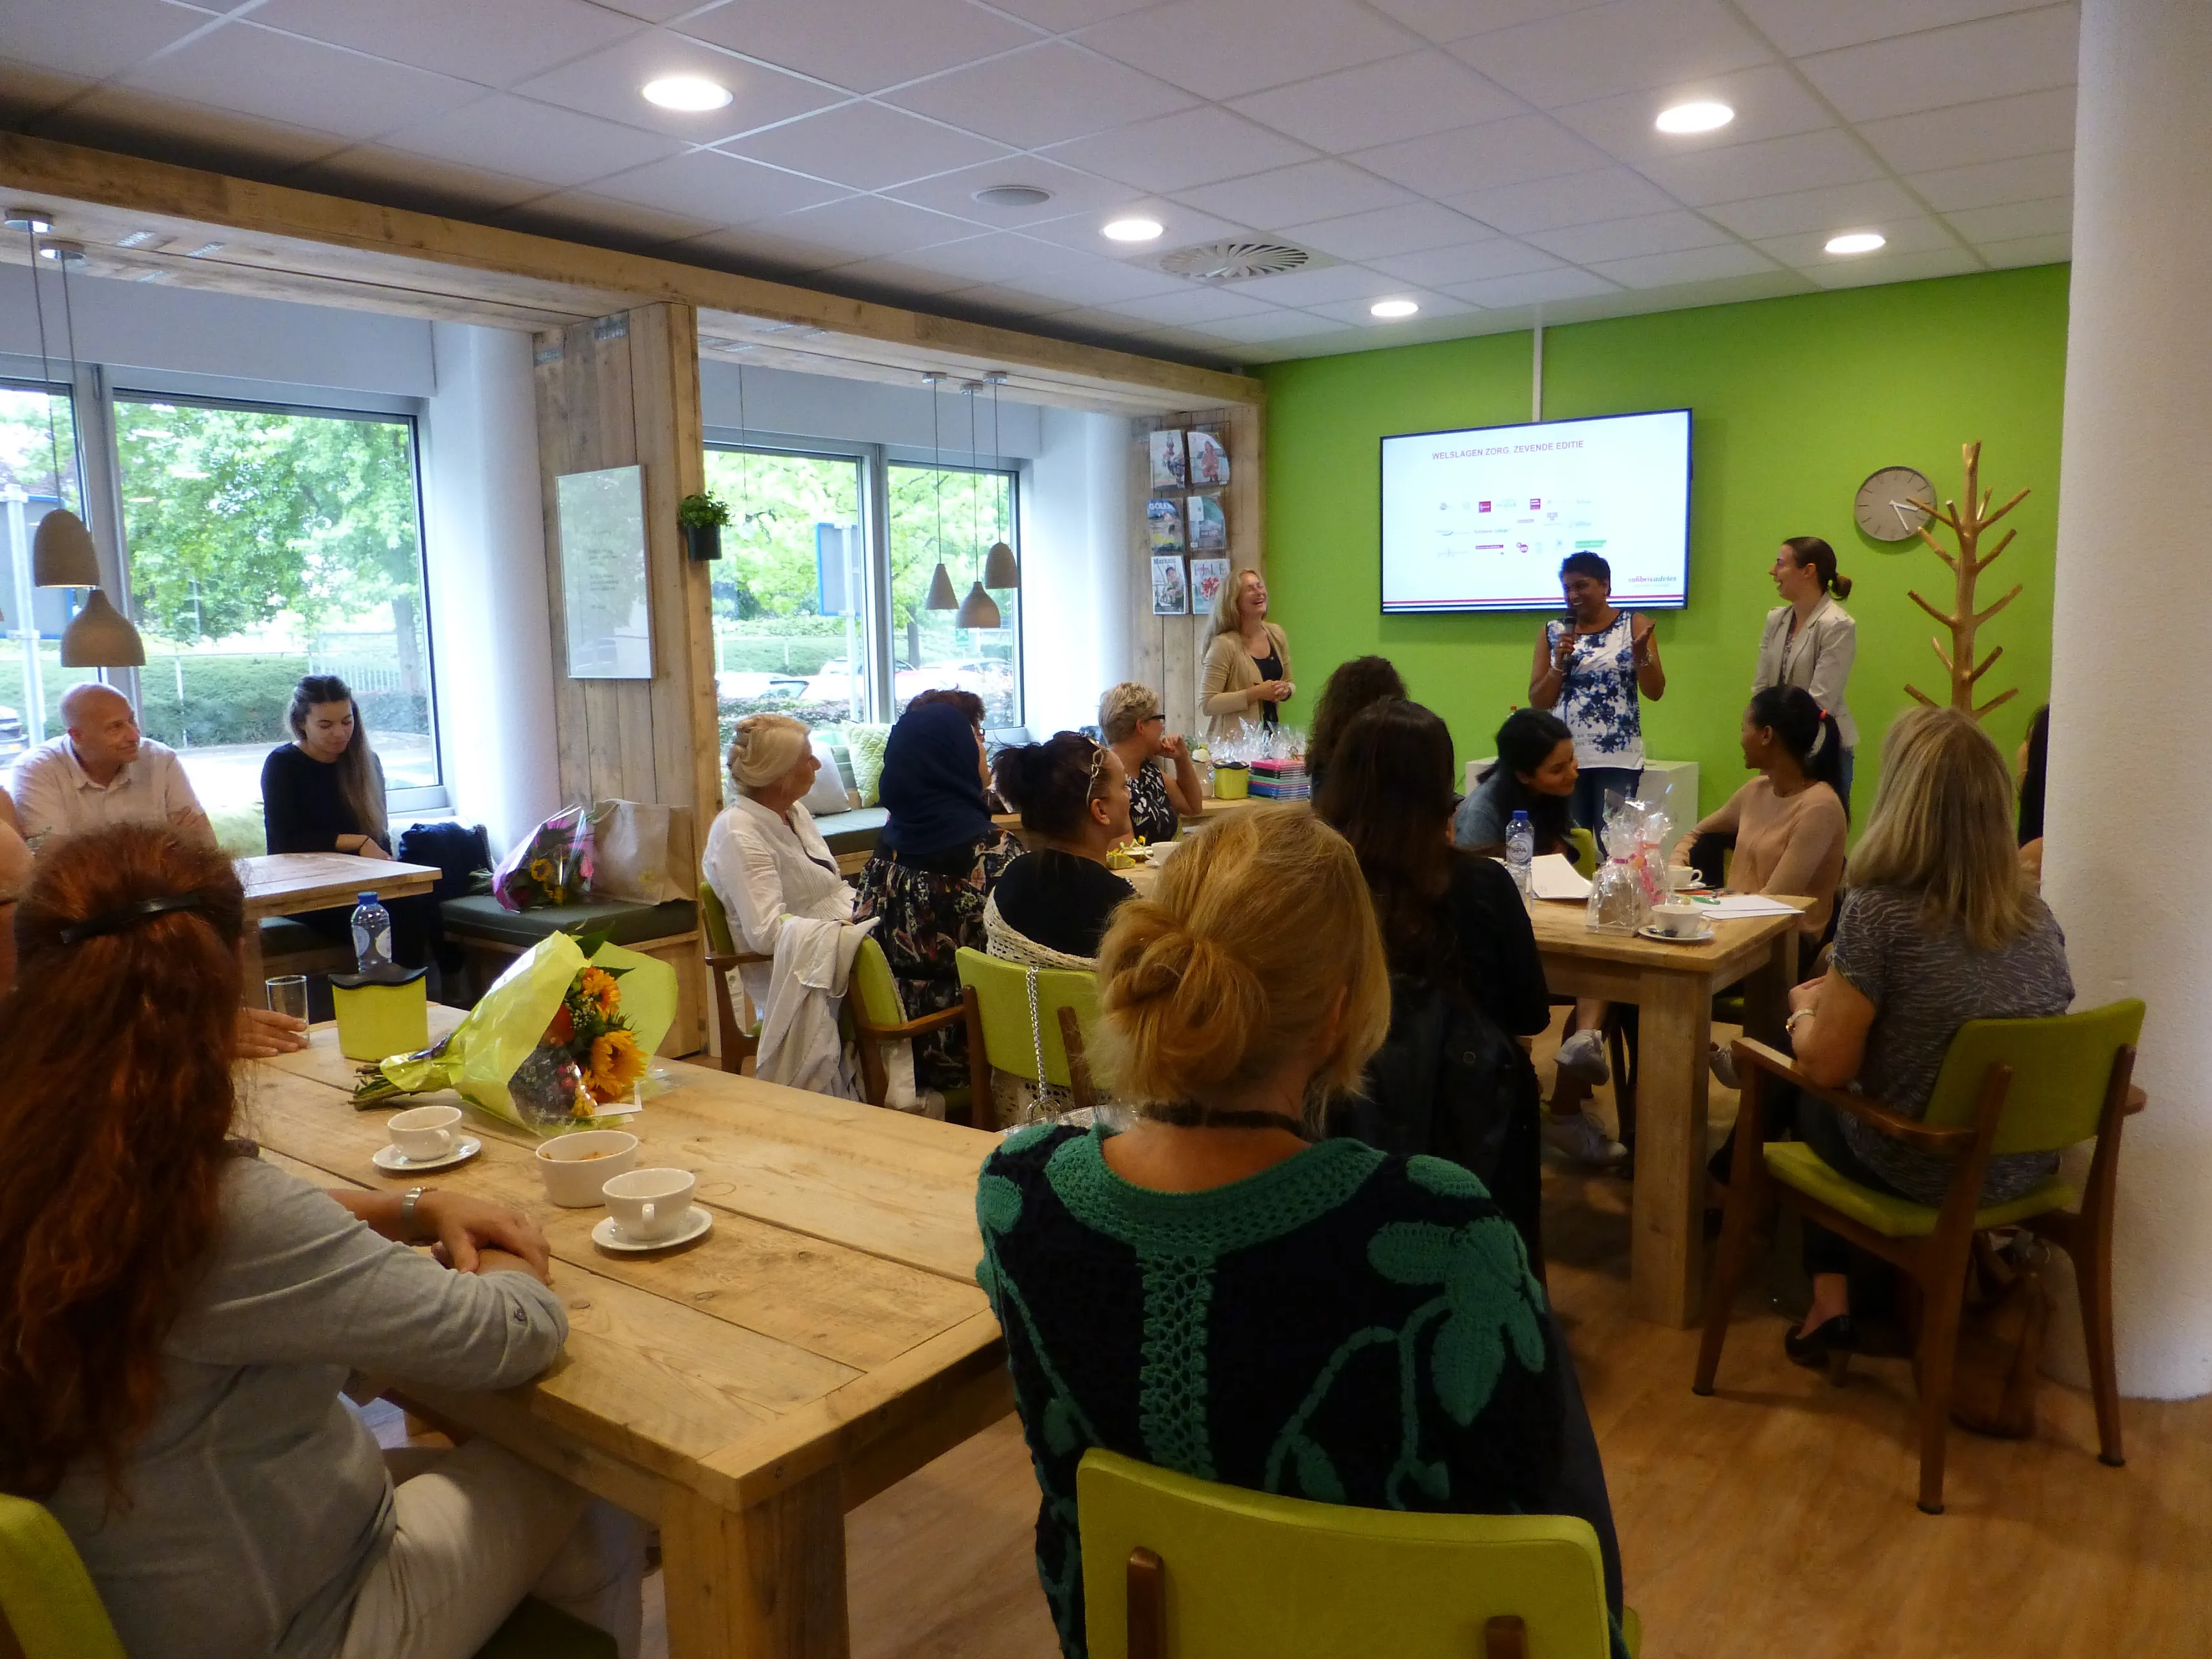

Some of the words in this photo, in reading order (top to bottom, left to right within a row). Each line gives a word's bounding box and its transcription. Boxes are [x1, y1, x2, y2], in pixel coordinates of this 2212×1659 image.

[1432, 448, 1483, 459] WELSLAGEN
[1513, 443, 1554, 454] ZEVENDE
[1555, 440, 1584, 450] EDITIE
